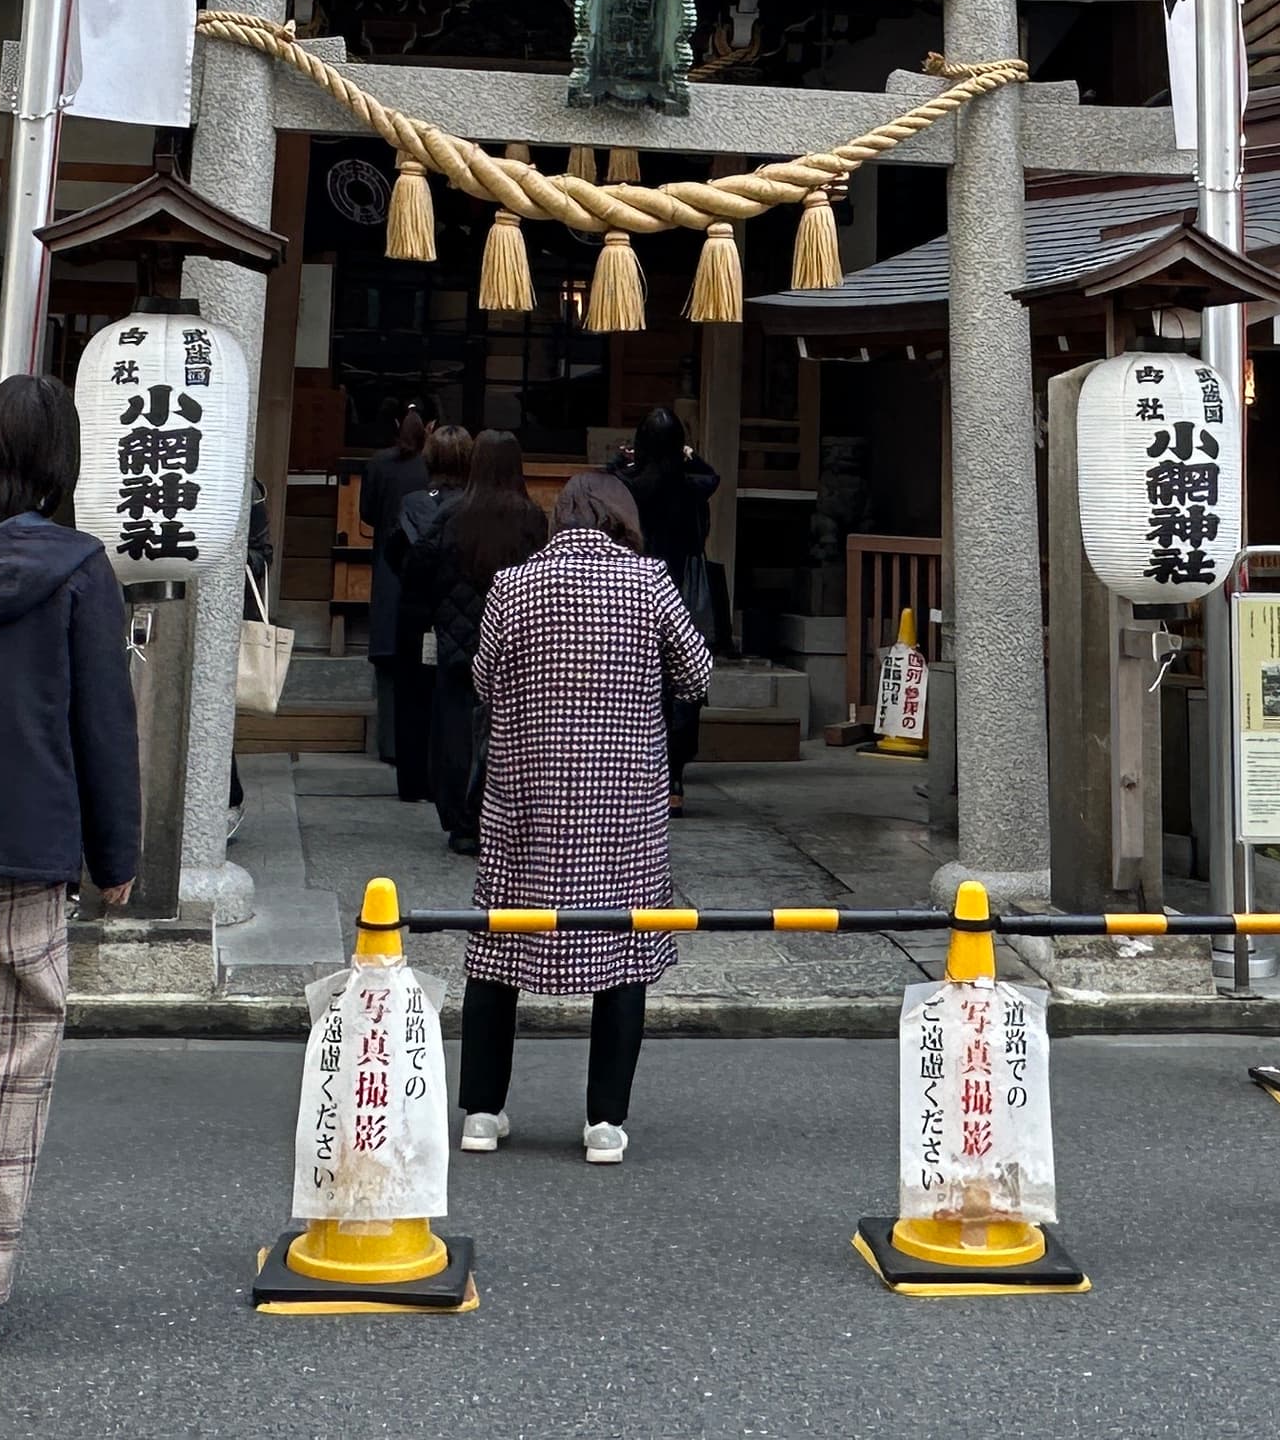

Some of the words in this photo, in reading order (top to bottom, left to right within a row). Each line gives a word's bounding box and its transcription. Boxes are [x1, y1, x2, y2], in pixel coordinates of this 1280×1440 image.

[116, 384, 203, 562] 小網神社
[1143, 421, 1221, 586] 小網神社
[353, 987, 393, 1153] 写真撮影
[405, 985, 427, 1101] 道路での
[961, 999, 993, 1158] 写真撮影
[1004, 1000, 1028, 1109] 道路での
